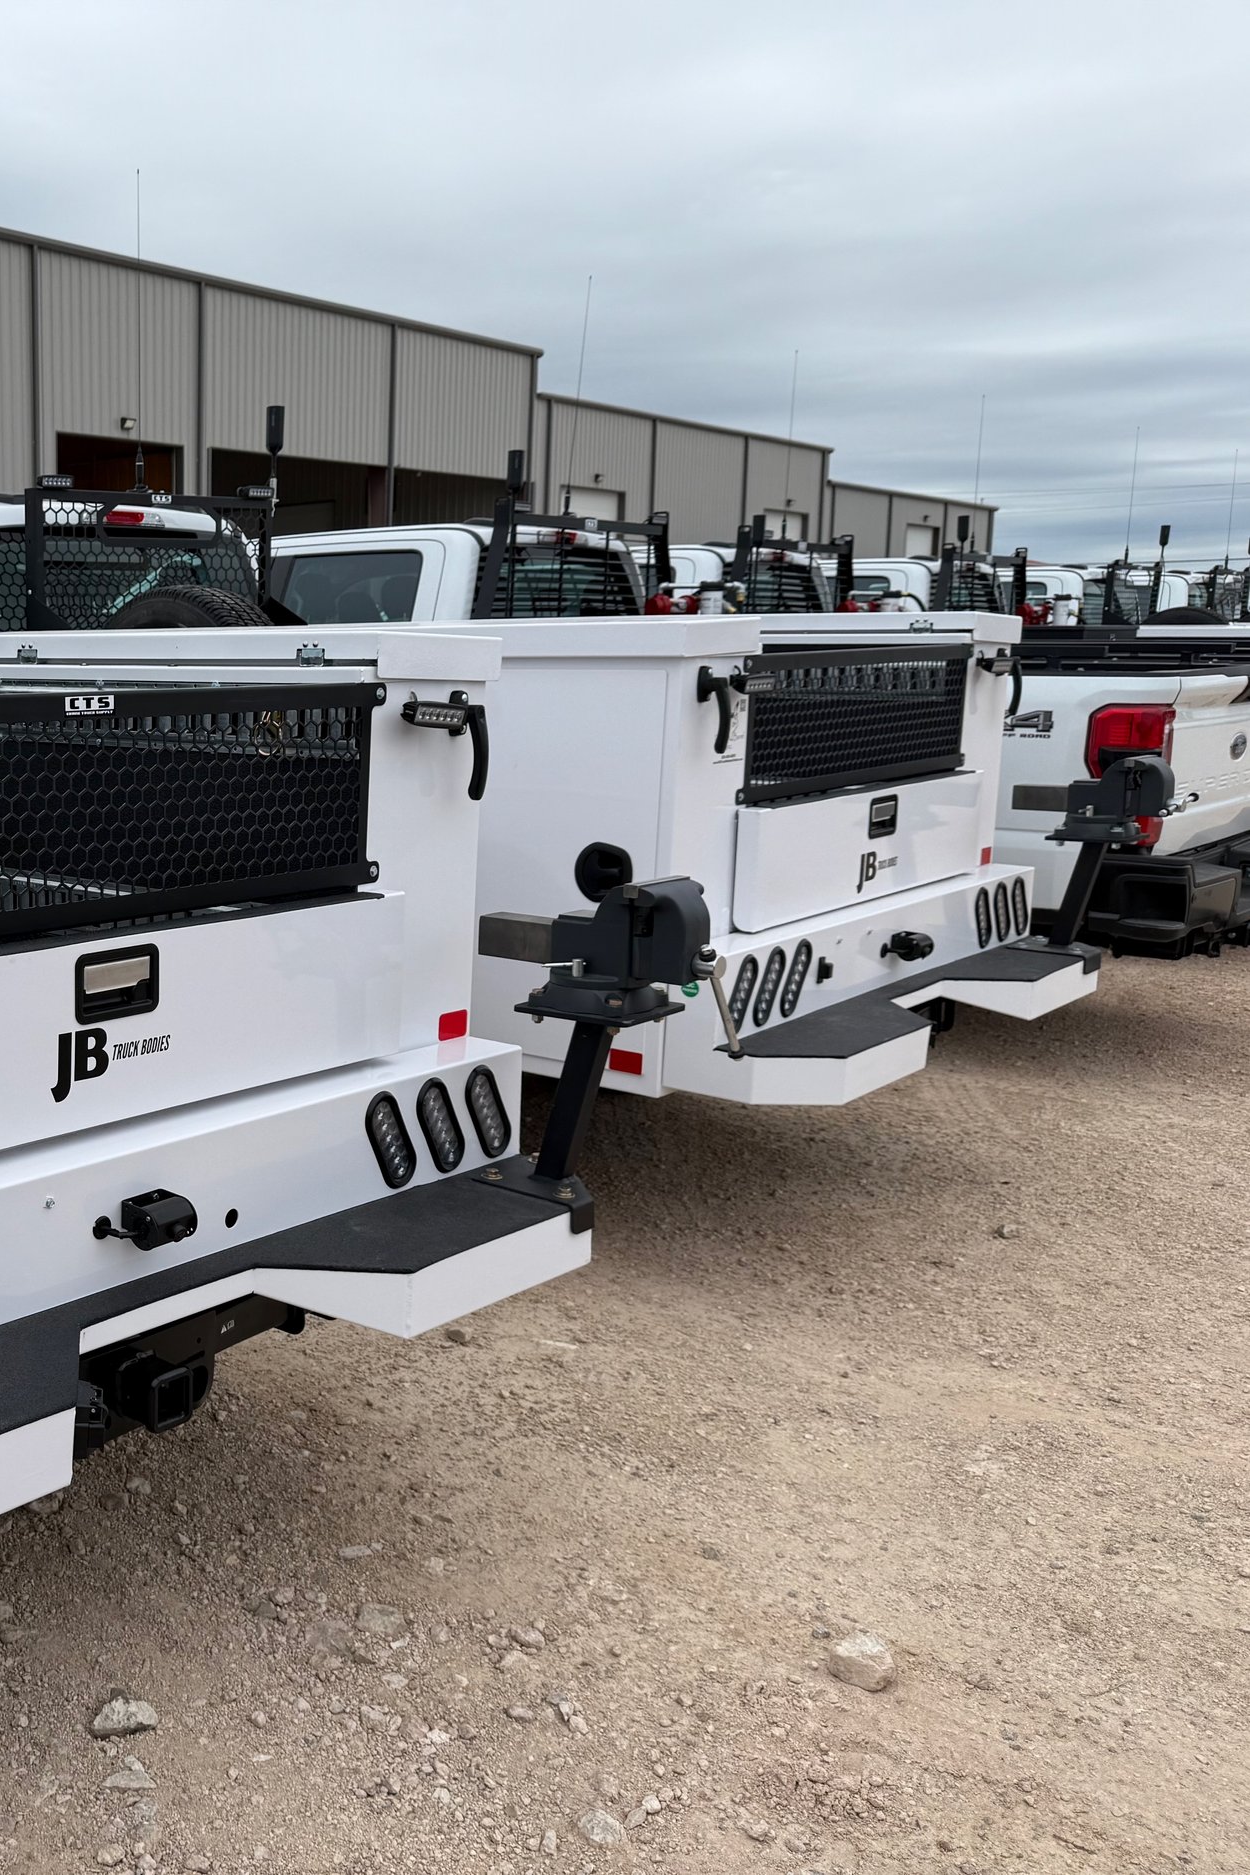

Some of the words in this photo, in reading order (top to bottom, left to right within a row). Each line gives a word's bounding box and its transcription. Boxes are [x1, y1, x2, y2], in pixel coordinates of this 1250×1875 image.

[69, 696, 110, 710] CTS
[856, 851, 877, 894] JB
[51, 1028, 109, 1103] JB
[112, 1040, 140, 1061] TRUCK
[140, 1034, 171, 1056] BODIES
